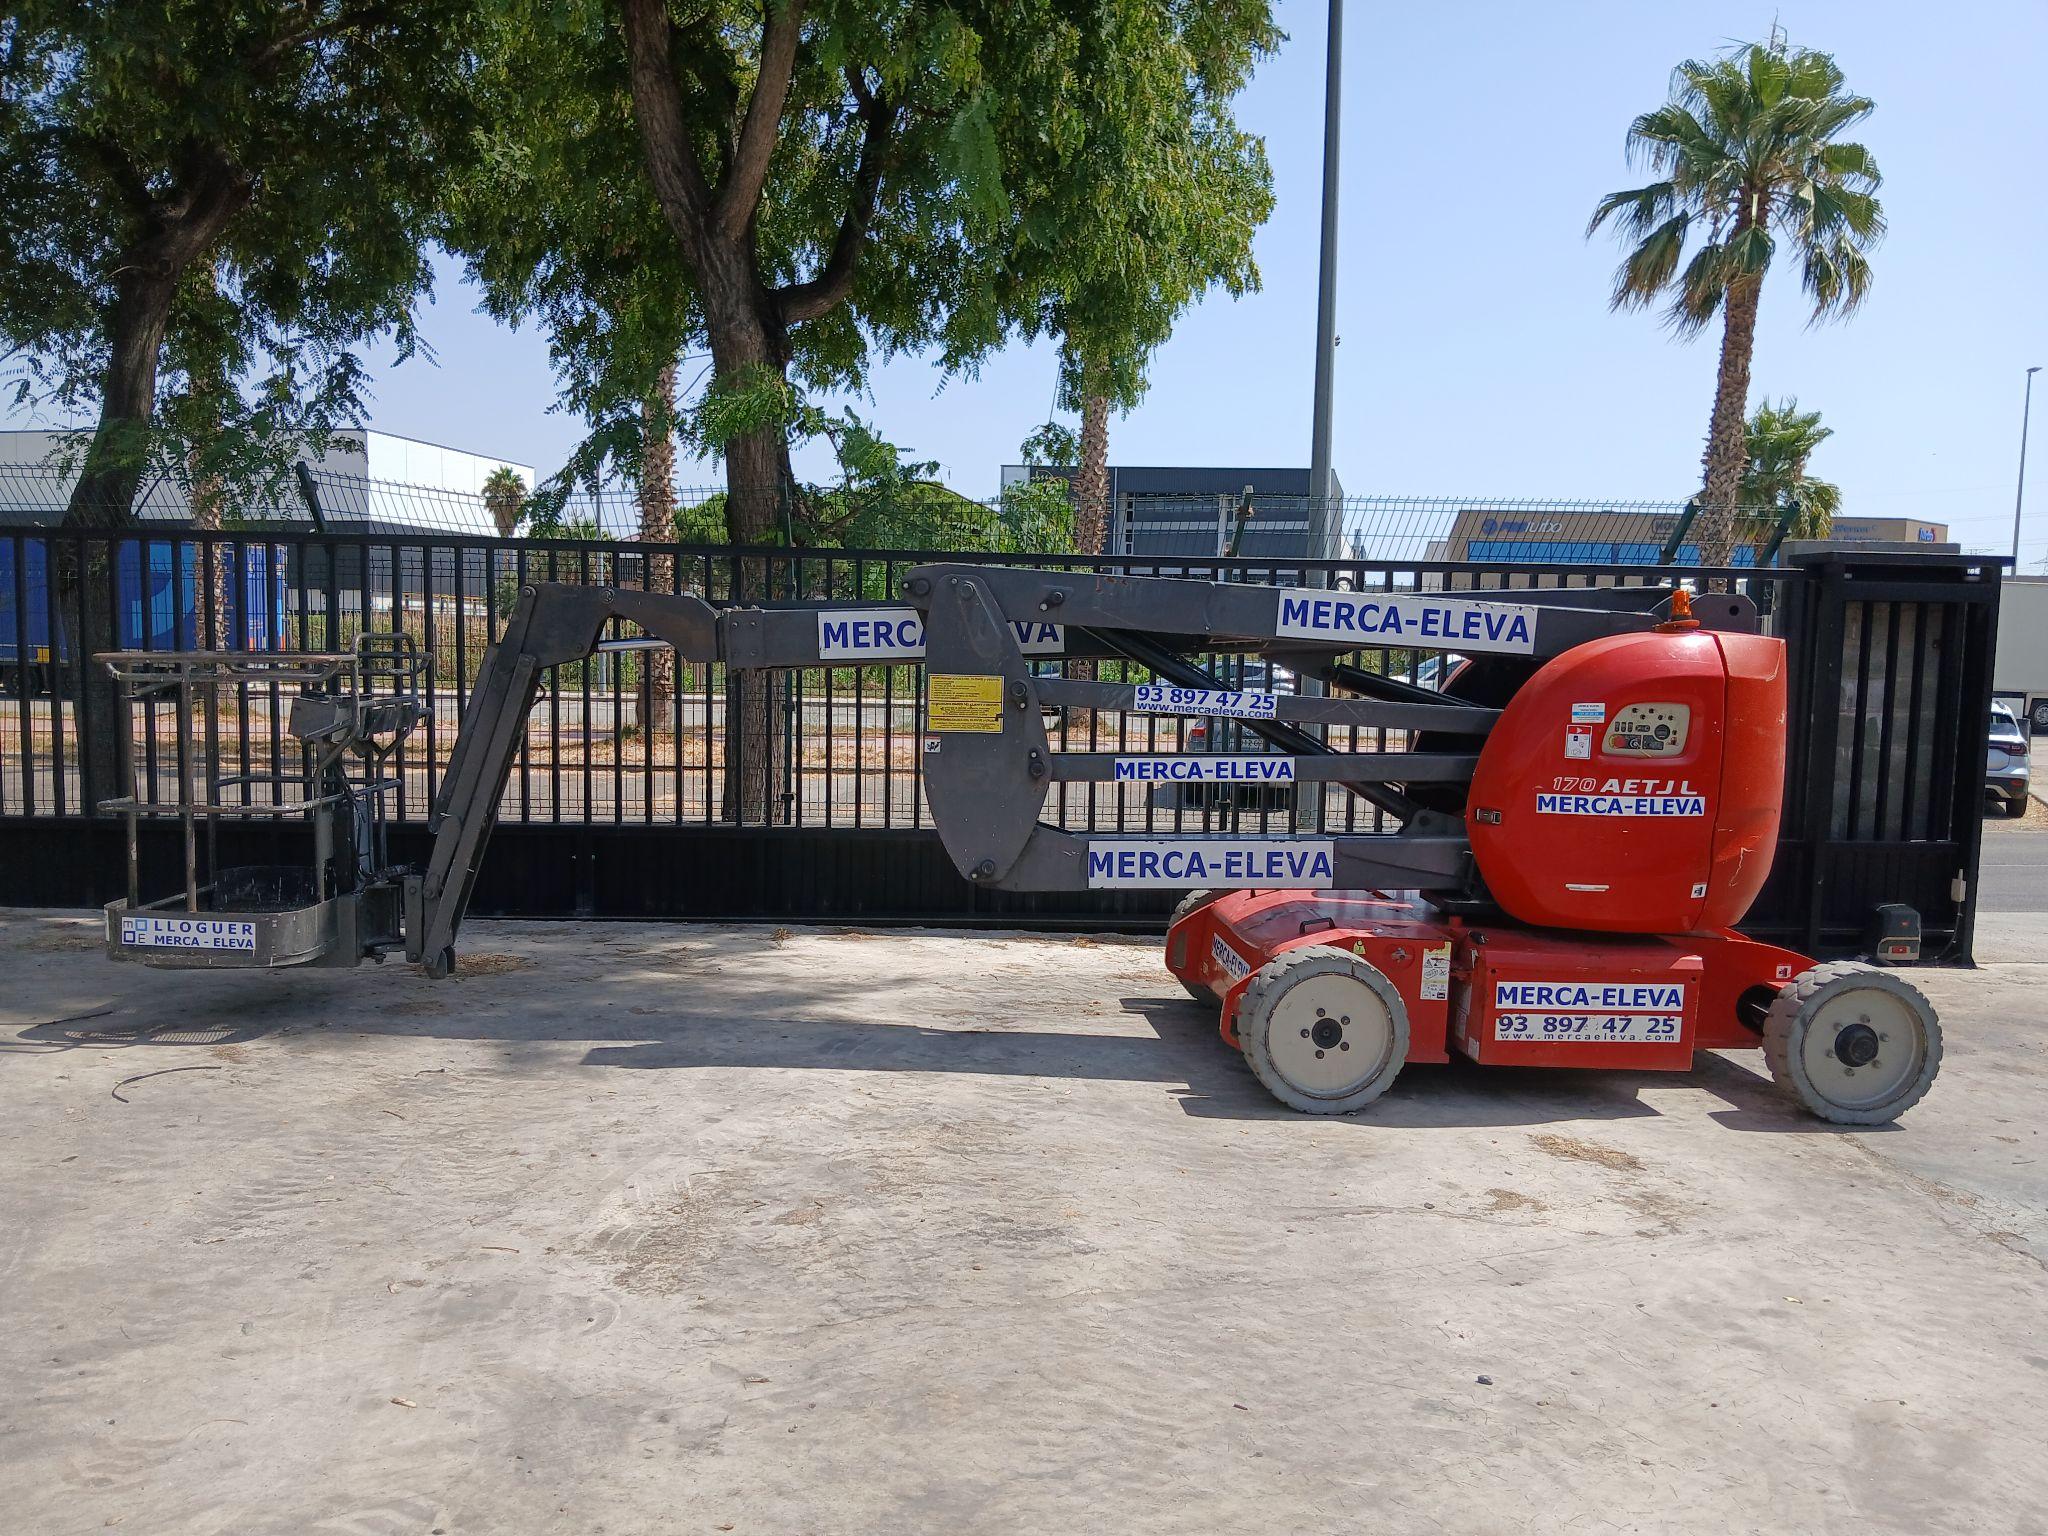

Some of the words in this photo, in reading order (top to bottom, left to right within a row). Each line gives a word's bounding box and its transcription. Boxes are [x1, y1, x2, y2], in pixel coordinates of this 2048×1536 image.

[1281, 598, 1530, 643] MERCA-ELEVA
[1137, 686, 1163, 702] 93
[1169, 688, 1210, 705] 897
[1215, 692, 1243, 708] 47
[1248, 694, 1275, 710] 25
[1136, 701, 1274, 719] www.mercaeleva.com
[1115, 761, 1293, 780] MERCA-ELEVA
[1552, 776, 1597, 793] 170
[1537, 795, 1703, 815] MERCA-ELEVA
[1088, 851, 1333, 879] MERCA-ELEVA
[154, 920, 253, 936] LLOGUER
[154, 935, 200, 947] MERCA
[213, 937, 254, 949] ELEVA
[1497, 986, 1682, 1007] MERCA-ELEVA
[1498, 1015, 1528, 1033] 93
[1542, 1016, 1589, 1033] 897
[1602, 1017, 1633, 1034] 47
[1646, 1017, 1675, 1034] 25
[1500, 1033, 1675, 1042] www.mercaeleva.com
